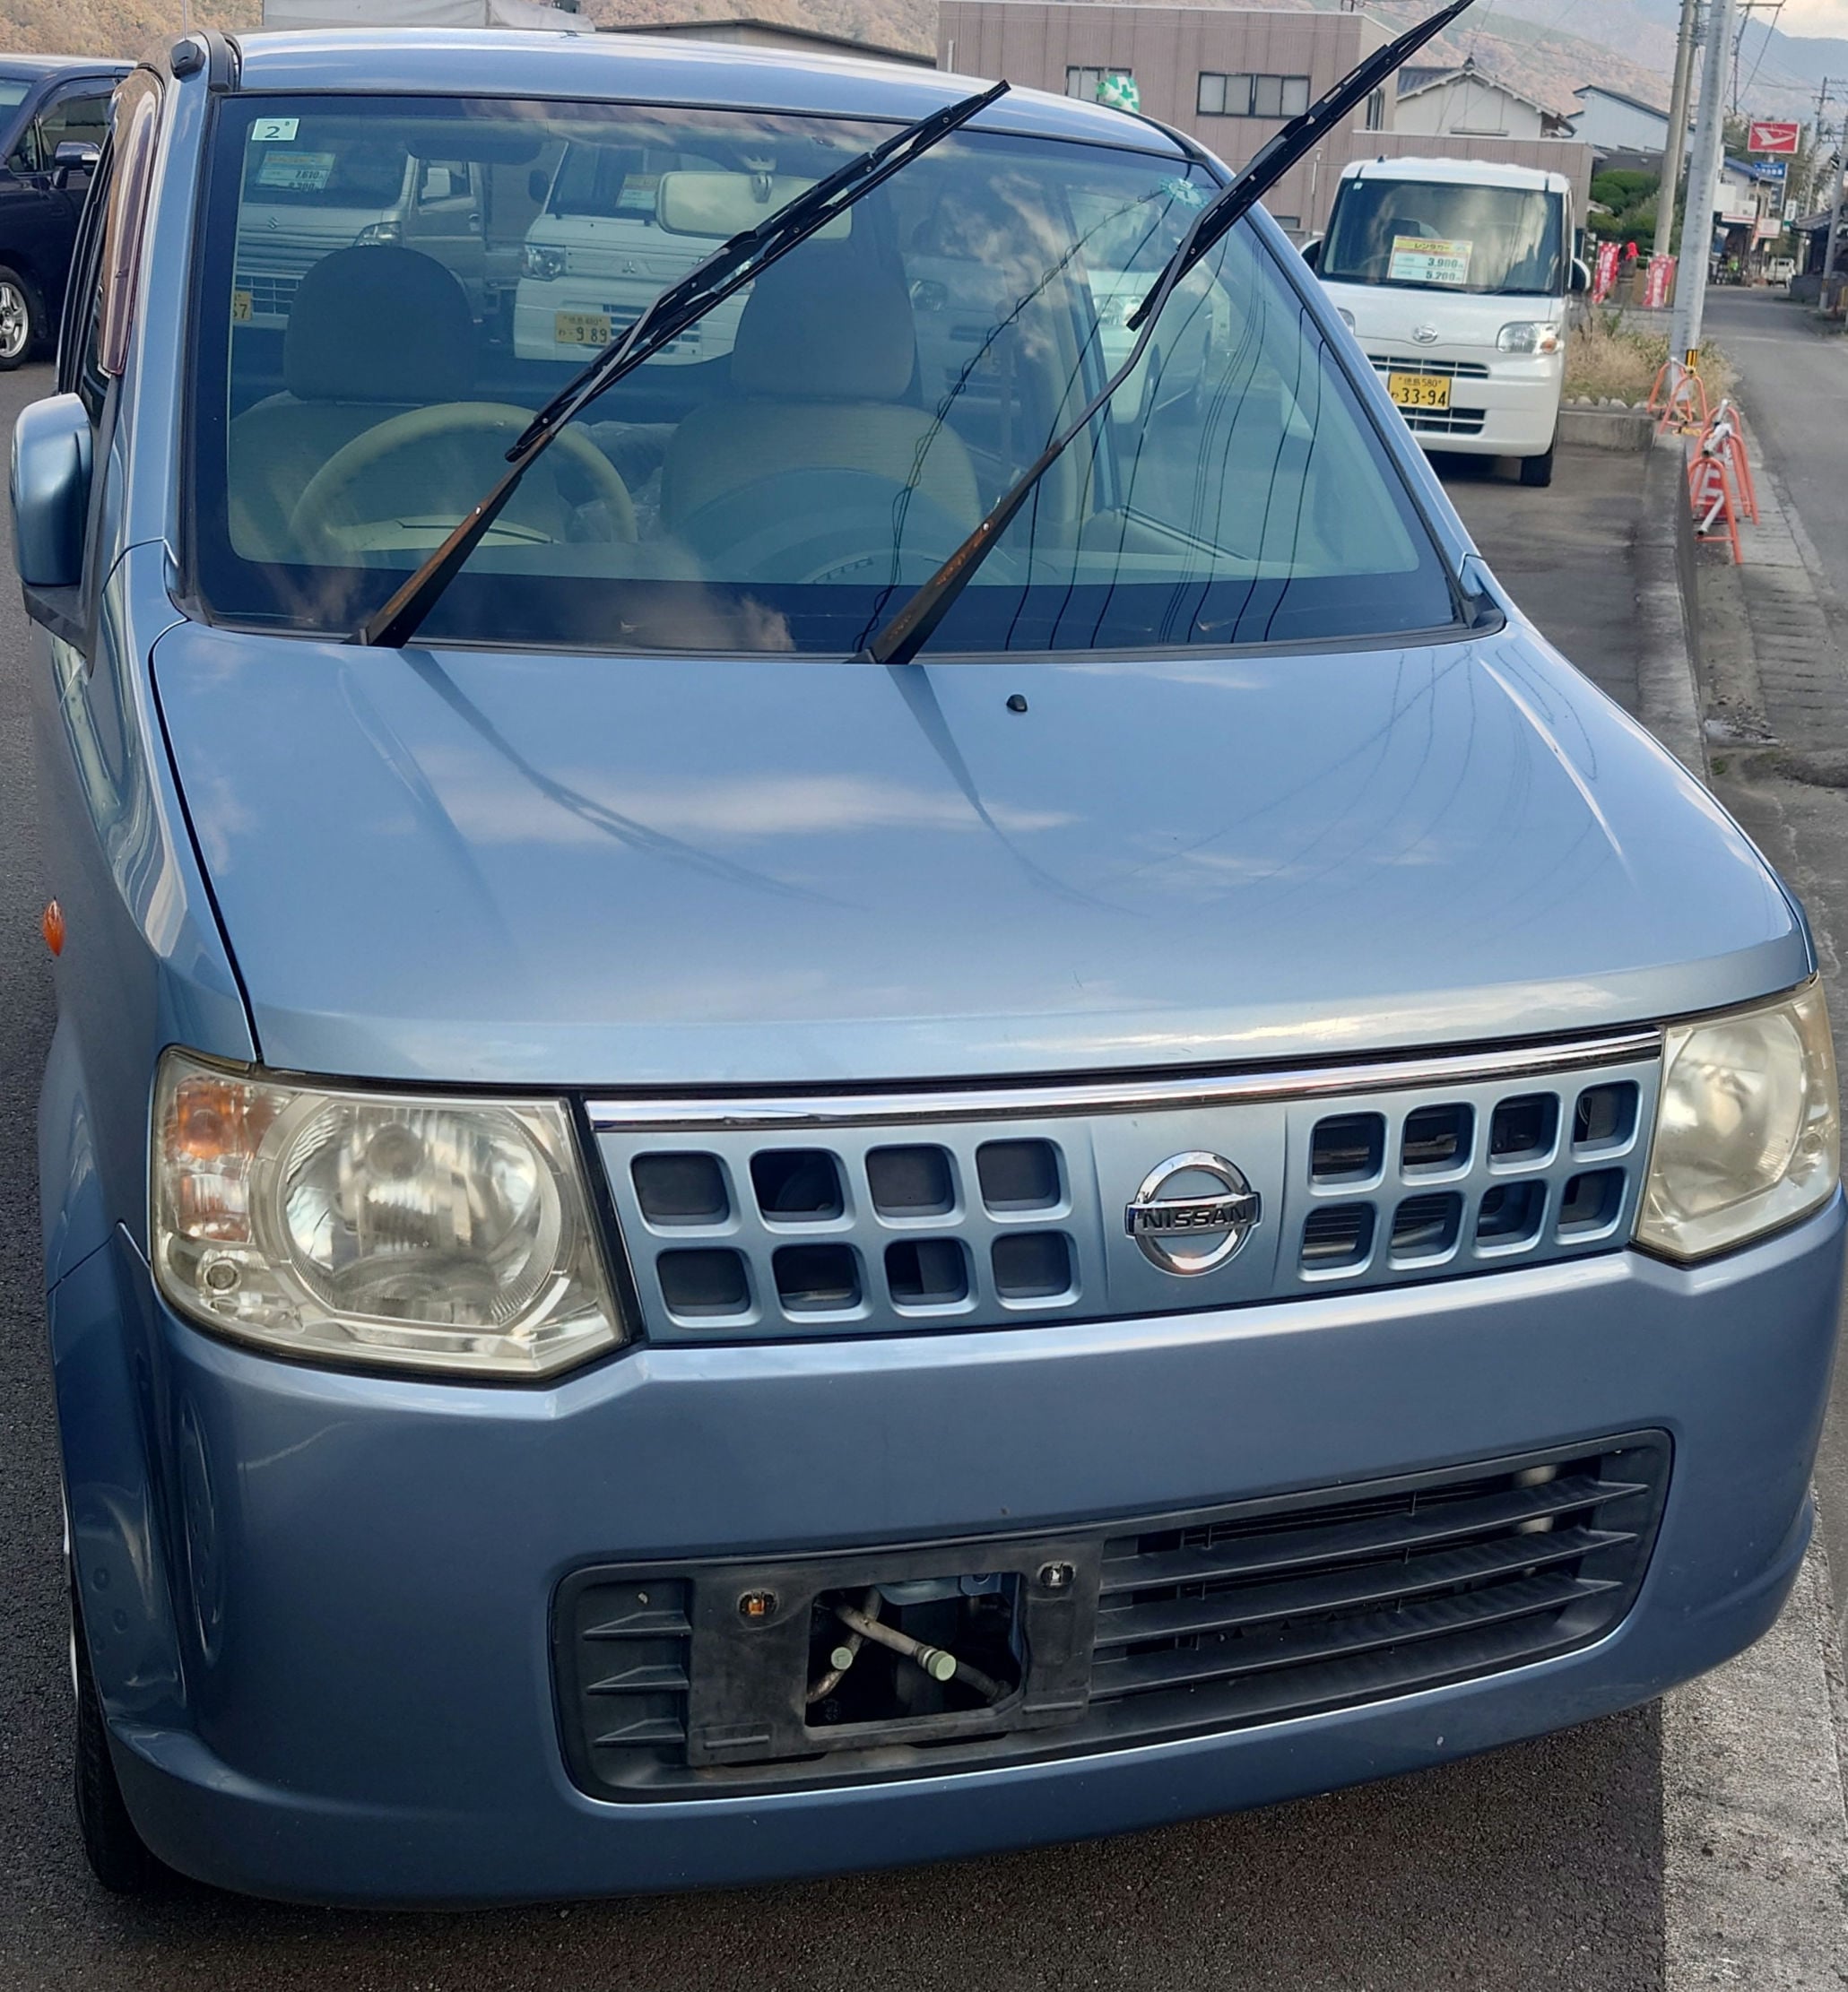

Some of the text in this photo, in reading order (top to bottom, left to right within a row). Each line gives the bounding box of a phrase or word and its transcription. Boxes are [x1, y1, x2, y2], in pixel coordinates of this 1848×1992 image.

[265, 126, 281, 139] 2
[1414, 243, 1450, 251] レンタカー
[1421, 378, 1438, 387] 580
[1401, 387, 1446, 407] 33-94
[1142, 1206, 1247, 1230] NISSAN
